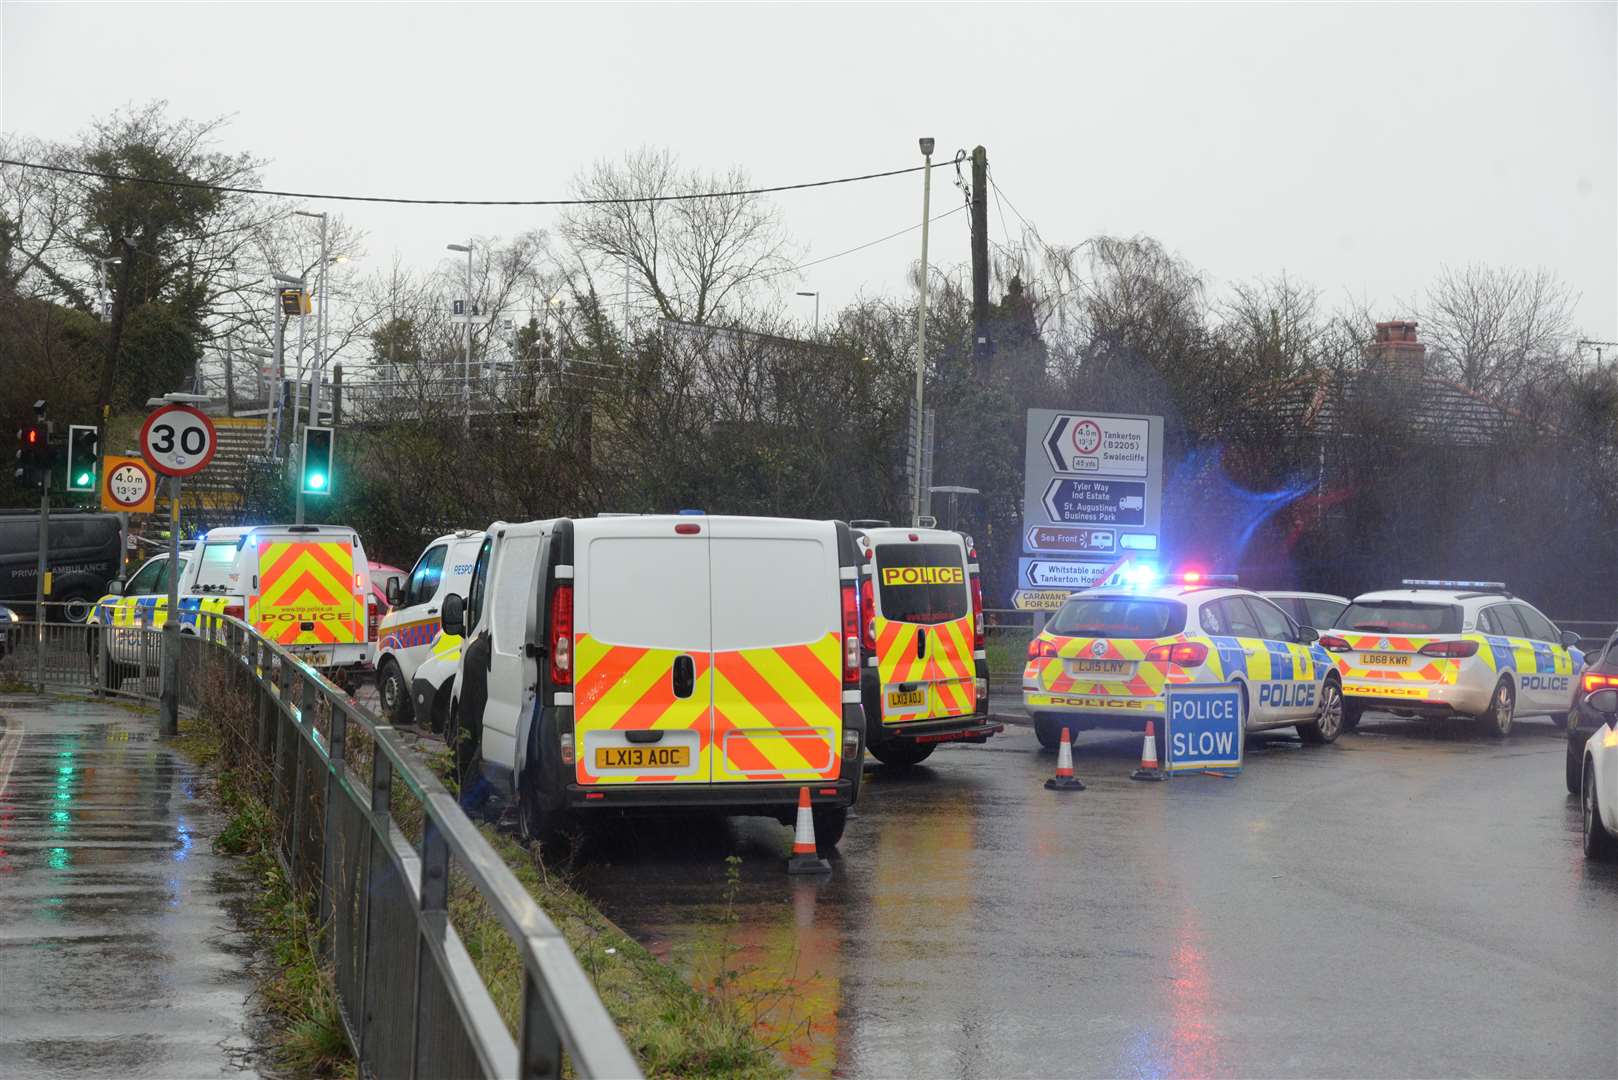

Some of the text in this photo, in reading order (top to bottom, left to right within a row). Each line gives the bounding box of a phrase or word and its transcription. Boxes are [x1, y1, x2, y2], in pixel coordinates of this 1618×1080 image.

[152, 424, 206, 455] 30
[1103, 431, 1141, 441] Tankerton
[1103, 441, 1140, 450] (B2205)
[1103, 452, 1145, 462] Swalecliffe
[1073, 481, 1109, 492] Tyler Way
[1086, 492, 1110, 500] Estate
[1076, 503, 1118, 513] Augustines
[1064, 511, 1116, 521] Business Park
[1040, 533, 1078, 543] Sea Front
[1048, 565, 1089, 575] Whitstable
[885, 568, 964, 584] POLICE
[1040, 575, 1079, 584] Tankerton
[1023, 592, 1067, 600] CARAVANS
[1025, 600, 1044, 608] FOR
[261, 612, 353, 621] POLICE
[1363, 655, 1408, 665] LD68 KWR
[1078, 661, 1125, 673] LJ15 LNY
[1520, 676, 1569, 690] POLICE
[1259, 683, 1316, 707] POLICE
[1343, 686, 1421, 695] POLICE
[1050, 697, 1142, 708] POLICE
[1172, 700, 1233, 720] POLICE
[1173, 731, 1233, 756] SLOW
[605, 749, 680, 766] LX13 AOC
